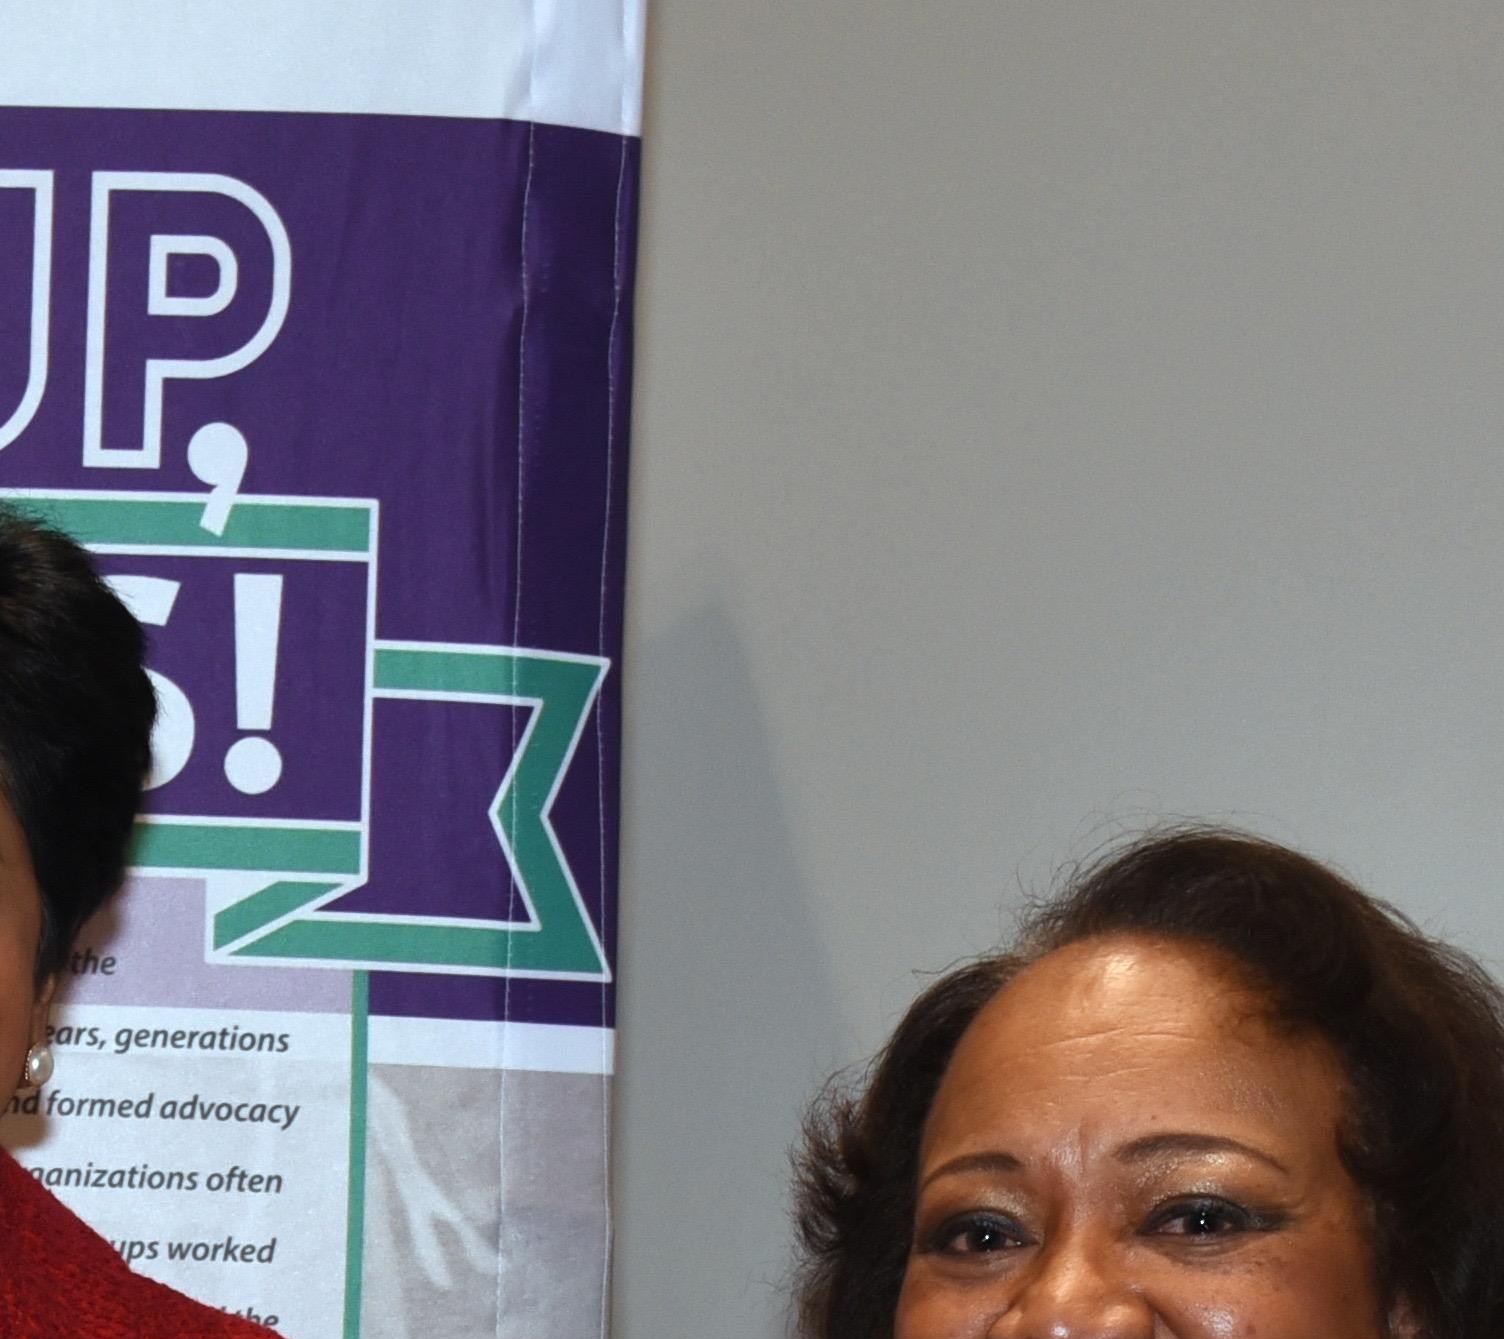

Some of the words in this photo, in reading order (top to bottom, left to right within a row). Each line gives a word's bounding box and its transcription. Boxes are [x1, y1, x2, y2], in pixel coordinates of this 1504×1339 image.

[71, 952, 117, 976] the
[45, 1026, 107, 1051] ears,
[114, 1025, 291, 1054] generations
[6, 1088, 41, 1115] nd
[45, 1090, 156, 1119] formed
[160, 1096, 301, 1131] advocacy
[205, 1165, 283, 1194] often
[168, 1237, 278, 1265] worked
